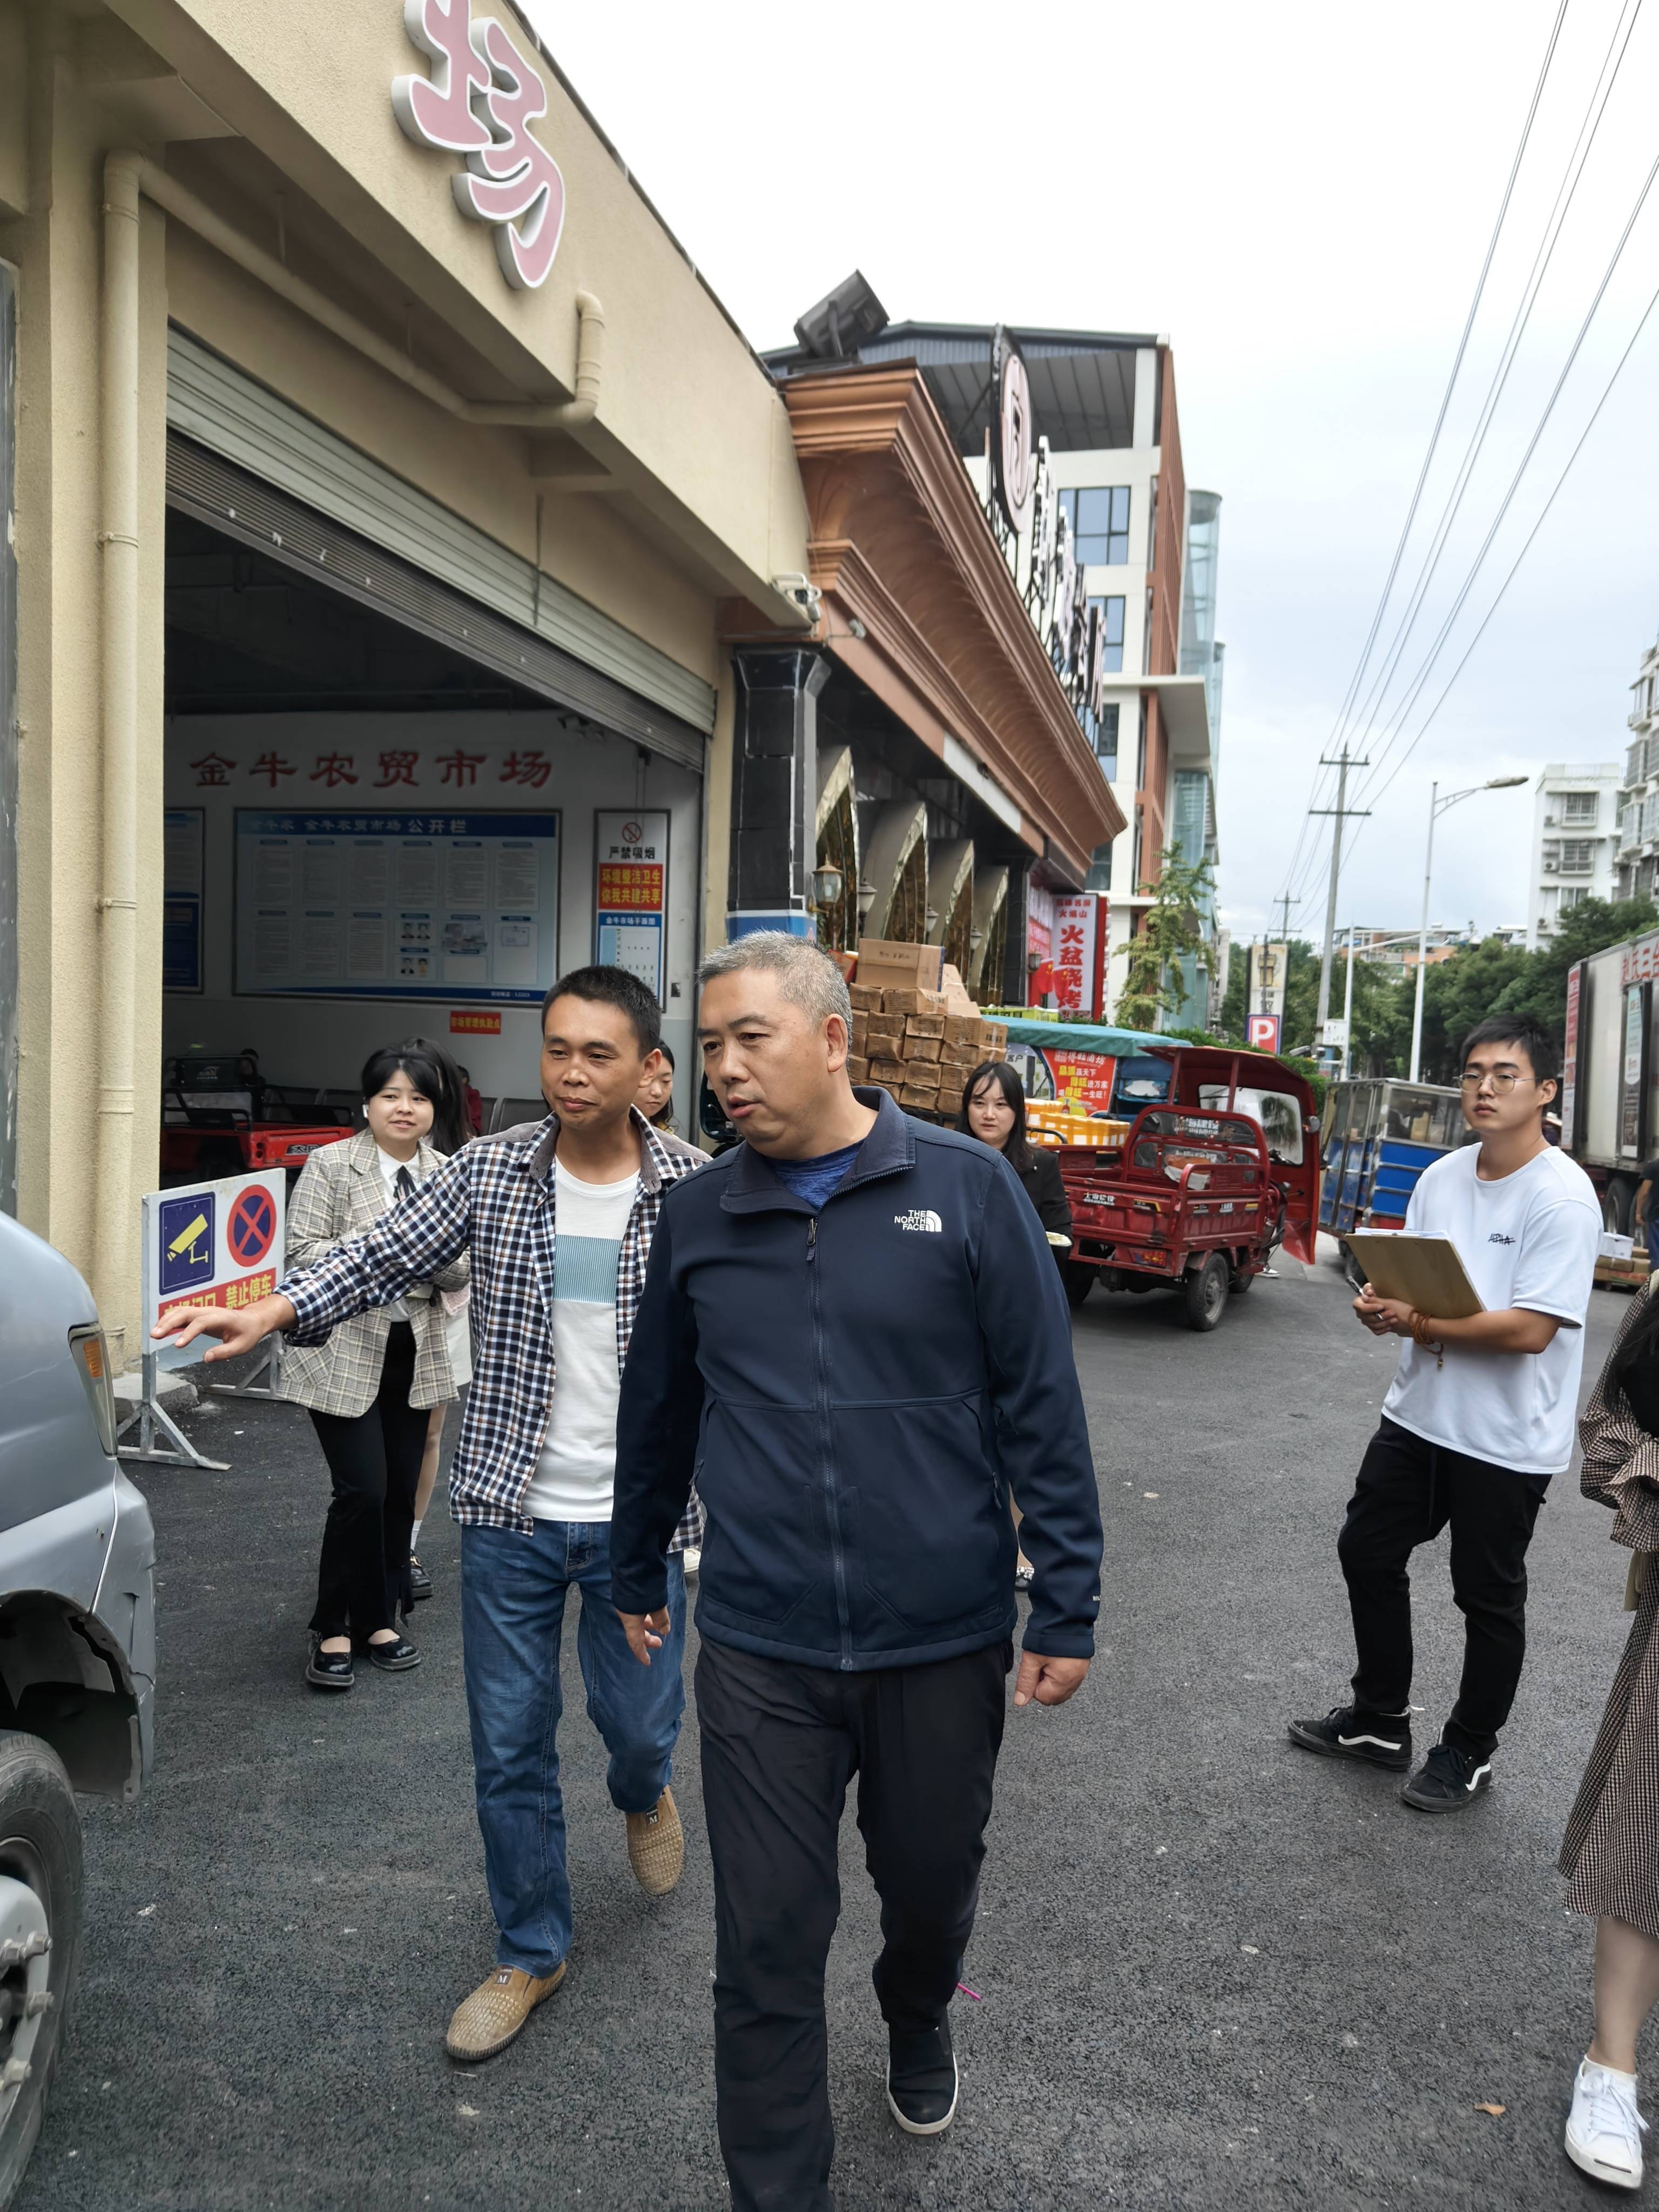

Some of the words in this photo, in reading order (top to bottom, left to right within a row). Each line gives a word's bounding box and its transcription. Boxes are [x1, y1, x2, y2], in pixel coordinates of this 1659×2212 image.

[190, 751, 552, 788] 金牛农贸市场
[408, 818, 467, 833] 公开栏
[609, 846, 656, 859] 严禁吸烟
[602, 868, 660, 884] 环境整洁卫生
[602, 887, 660, 904] 你我共建共享
[1252, 1019, 1275, 1047] P
[894, 1216, 926, 1224] NORTH
[226, 1274, 272, 1310] 禁止停车
[649, 1815, 658, 1824] M
[497, 1975, 508, 1984] M
